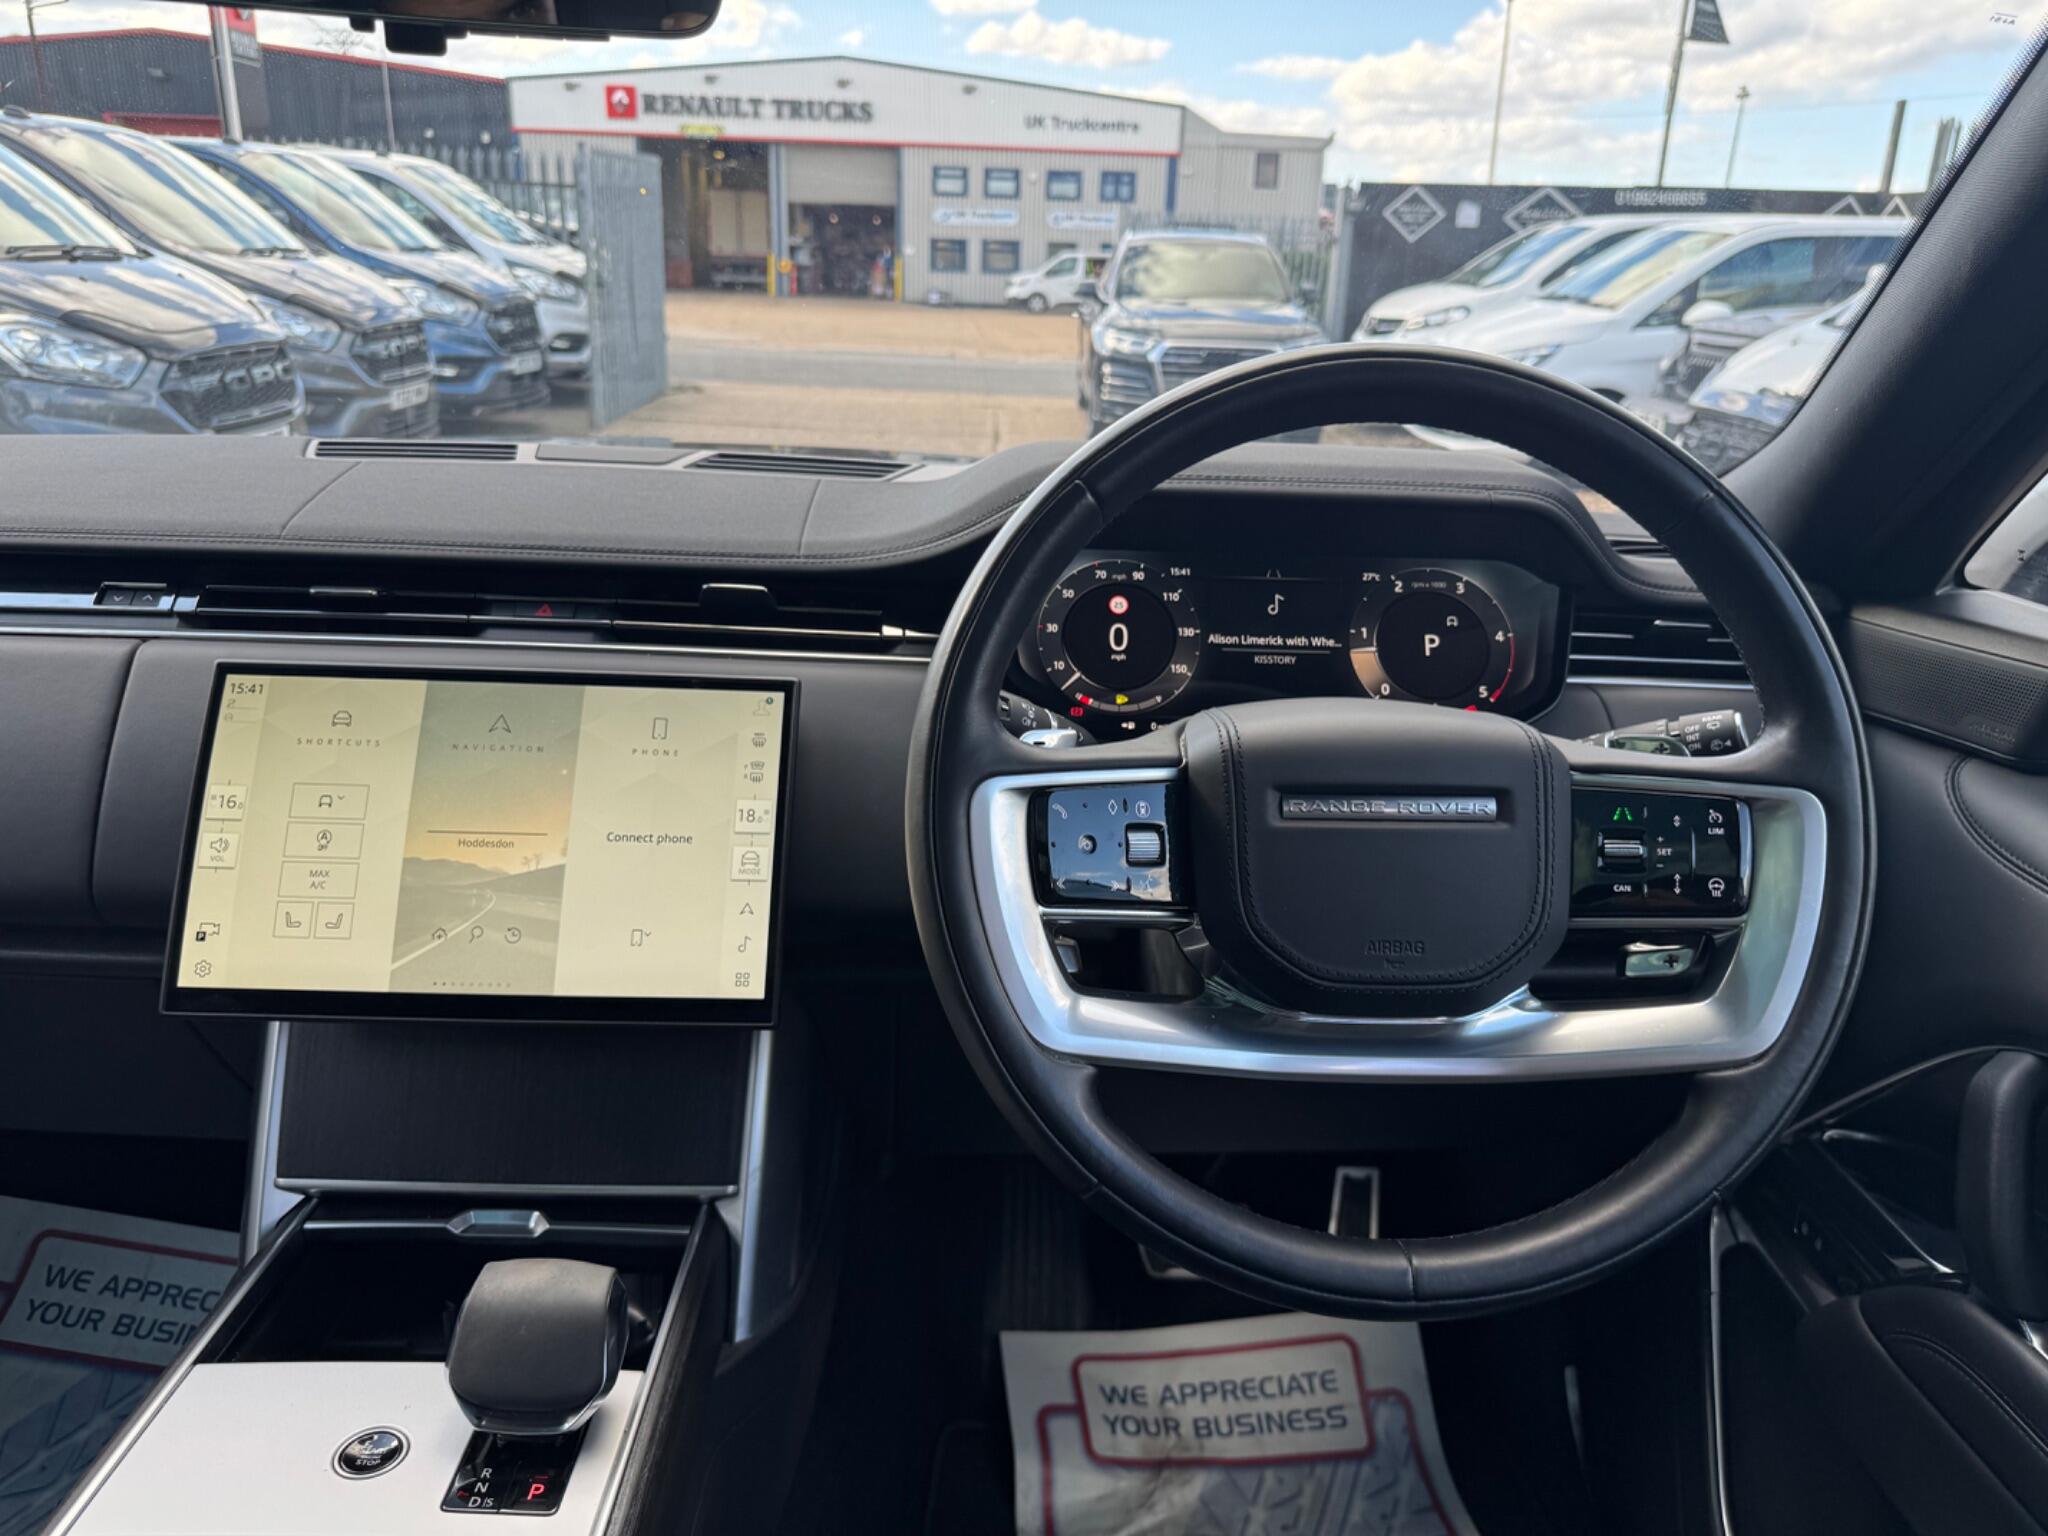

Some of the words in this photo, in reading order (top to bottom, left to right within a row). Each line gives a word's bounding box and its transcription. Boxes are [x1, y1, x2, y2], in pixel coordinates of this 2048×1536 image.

[641, 93, 763, 119] RENAULT
[771, 98, 873, 122] TRUCKS
[1023, 114, 1045, 130] UK
[1051, 115, 1140, 133] Truckcentre
[1094, 570, 1107, 579] 70
[1132, 571, 1145, 581] 90
[1170, 567, 1191, 576] 15:41
[1394, 580, 1404, 593] 2
[1456, 582, 1465, 594] 3
[1062, 589, 1075, 598] 50
[1163, 591, 1180, 602] 110
[1046, 623, 1058, 633] 30
[1178, 627, 1195, 637] 130
[1360, 627, 1367, 638] 1
[1109, 623, 1129, 652] 0
[1208, 634, 1239, 645] Alison
[1241, 635, 1284, 646] Limerick
[1286, 636, 1309, 647] with
[1495, 630, 1504, 641] 4
[1424, 634, 1441, 657] P
[1111, 653, 1127, 661] mph
[1254, 655, 1297, 665] KISSTORY
[1053, 661, 1065, 671] 10
[1171, 664, 1187, 674] 150
[231, 682, 264, 695] 15:41
[1380, 684, 1391, 695] 0
[1478, 686, 1488, 697] 5
[297, 737, 381, 748] SHORTCUTS
[453, 743, 545, 753] NAVIGATION
[632, 748, 680, 757] PHONE
[1289, 799, 1386, 814] RANGE
[1397, 799, 1492, 815] ROVER
[1708, 827, 1725, 836] LIM
[458, 837, 515, 849] Hoddesdon
[606, 831, 654, 845] Connect
[656, 833, 693, 847] phone
[1656, 848, 1673, 856] SET
[210, 855, 224, 863] VOL
[309, 869, 330, 878] MAX
[309, 880, 326, 890] A/C
[1613, 884, 1632, 893] CAN
[1365, 939, 1425, 956] AIRBAG
[45, 1263, 95, 1293] WE
[25, 1298, 105, 1333] YOUR
[1098, 1383, 1147, 1406] WE
[1159, 1369, 1339, 1406] APPRECIATE
[1102, 1414, 1181, 1439] YOUR
[1193, 1405, 1348, 1439] BUSINESS
[480, 1467, 493, 1479] R
[473, 1481, 490, 1493] N
[526, 1482, 545, 1501] P
